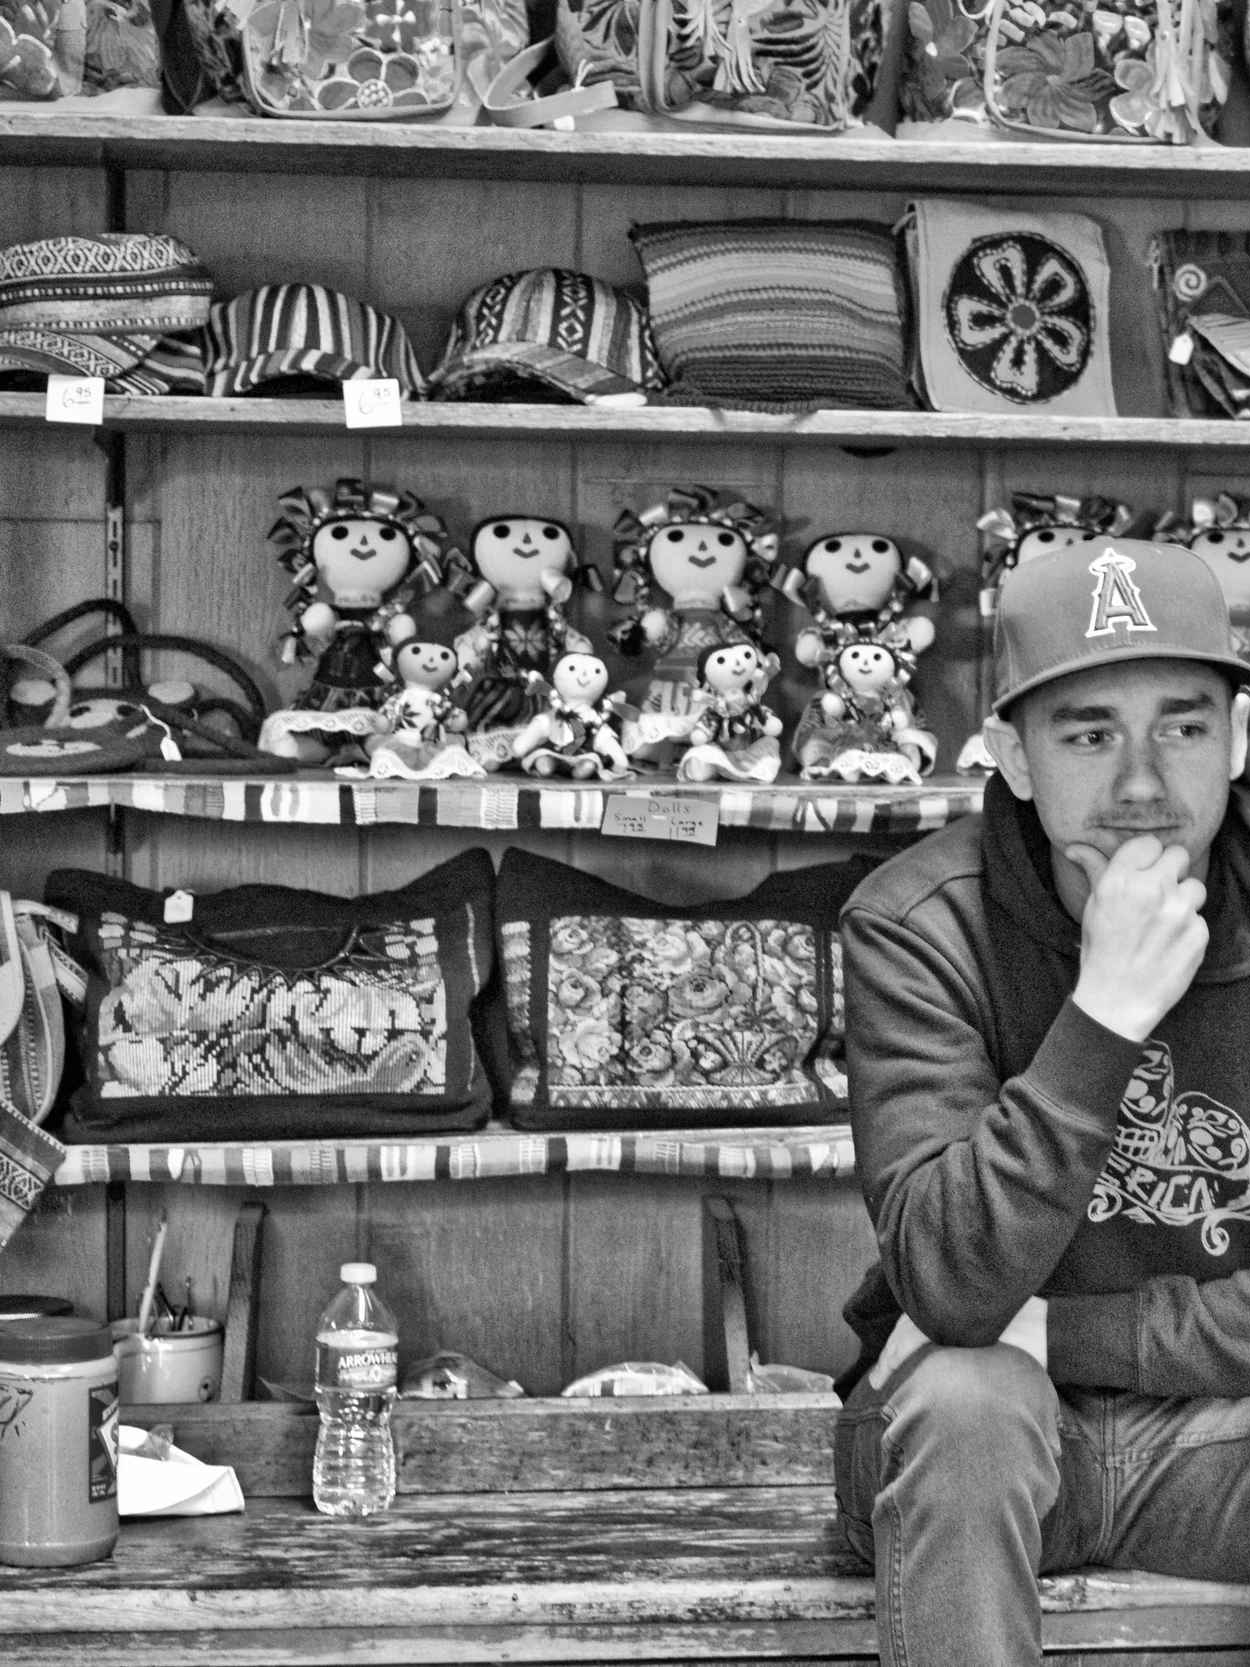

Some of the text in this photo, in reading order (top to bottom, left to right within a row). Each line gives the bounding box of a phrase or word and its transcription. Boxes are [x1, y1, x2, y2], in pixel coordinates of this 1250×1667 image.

[1085, 547, 1157, 638] A
[648, 800, 690, 813] Dolls
[614, 812, 703, 828] Small Large
